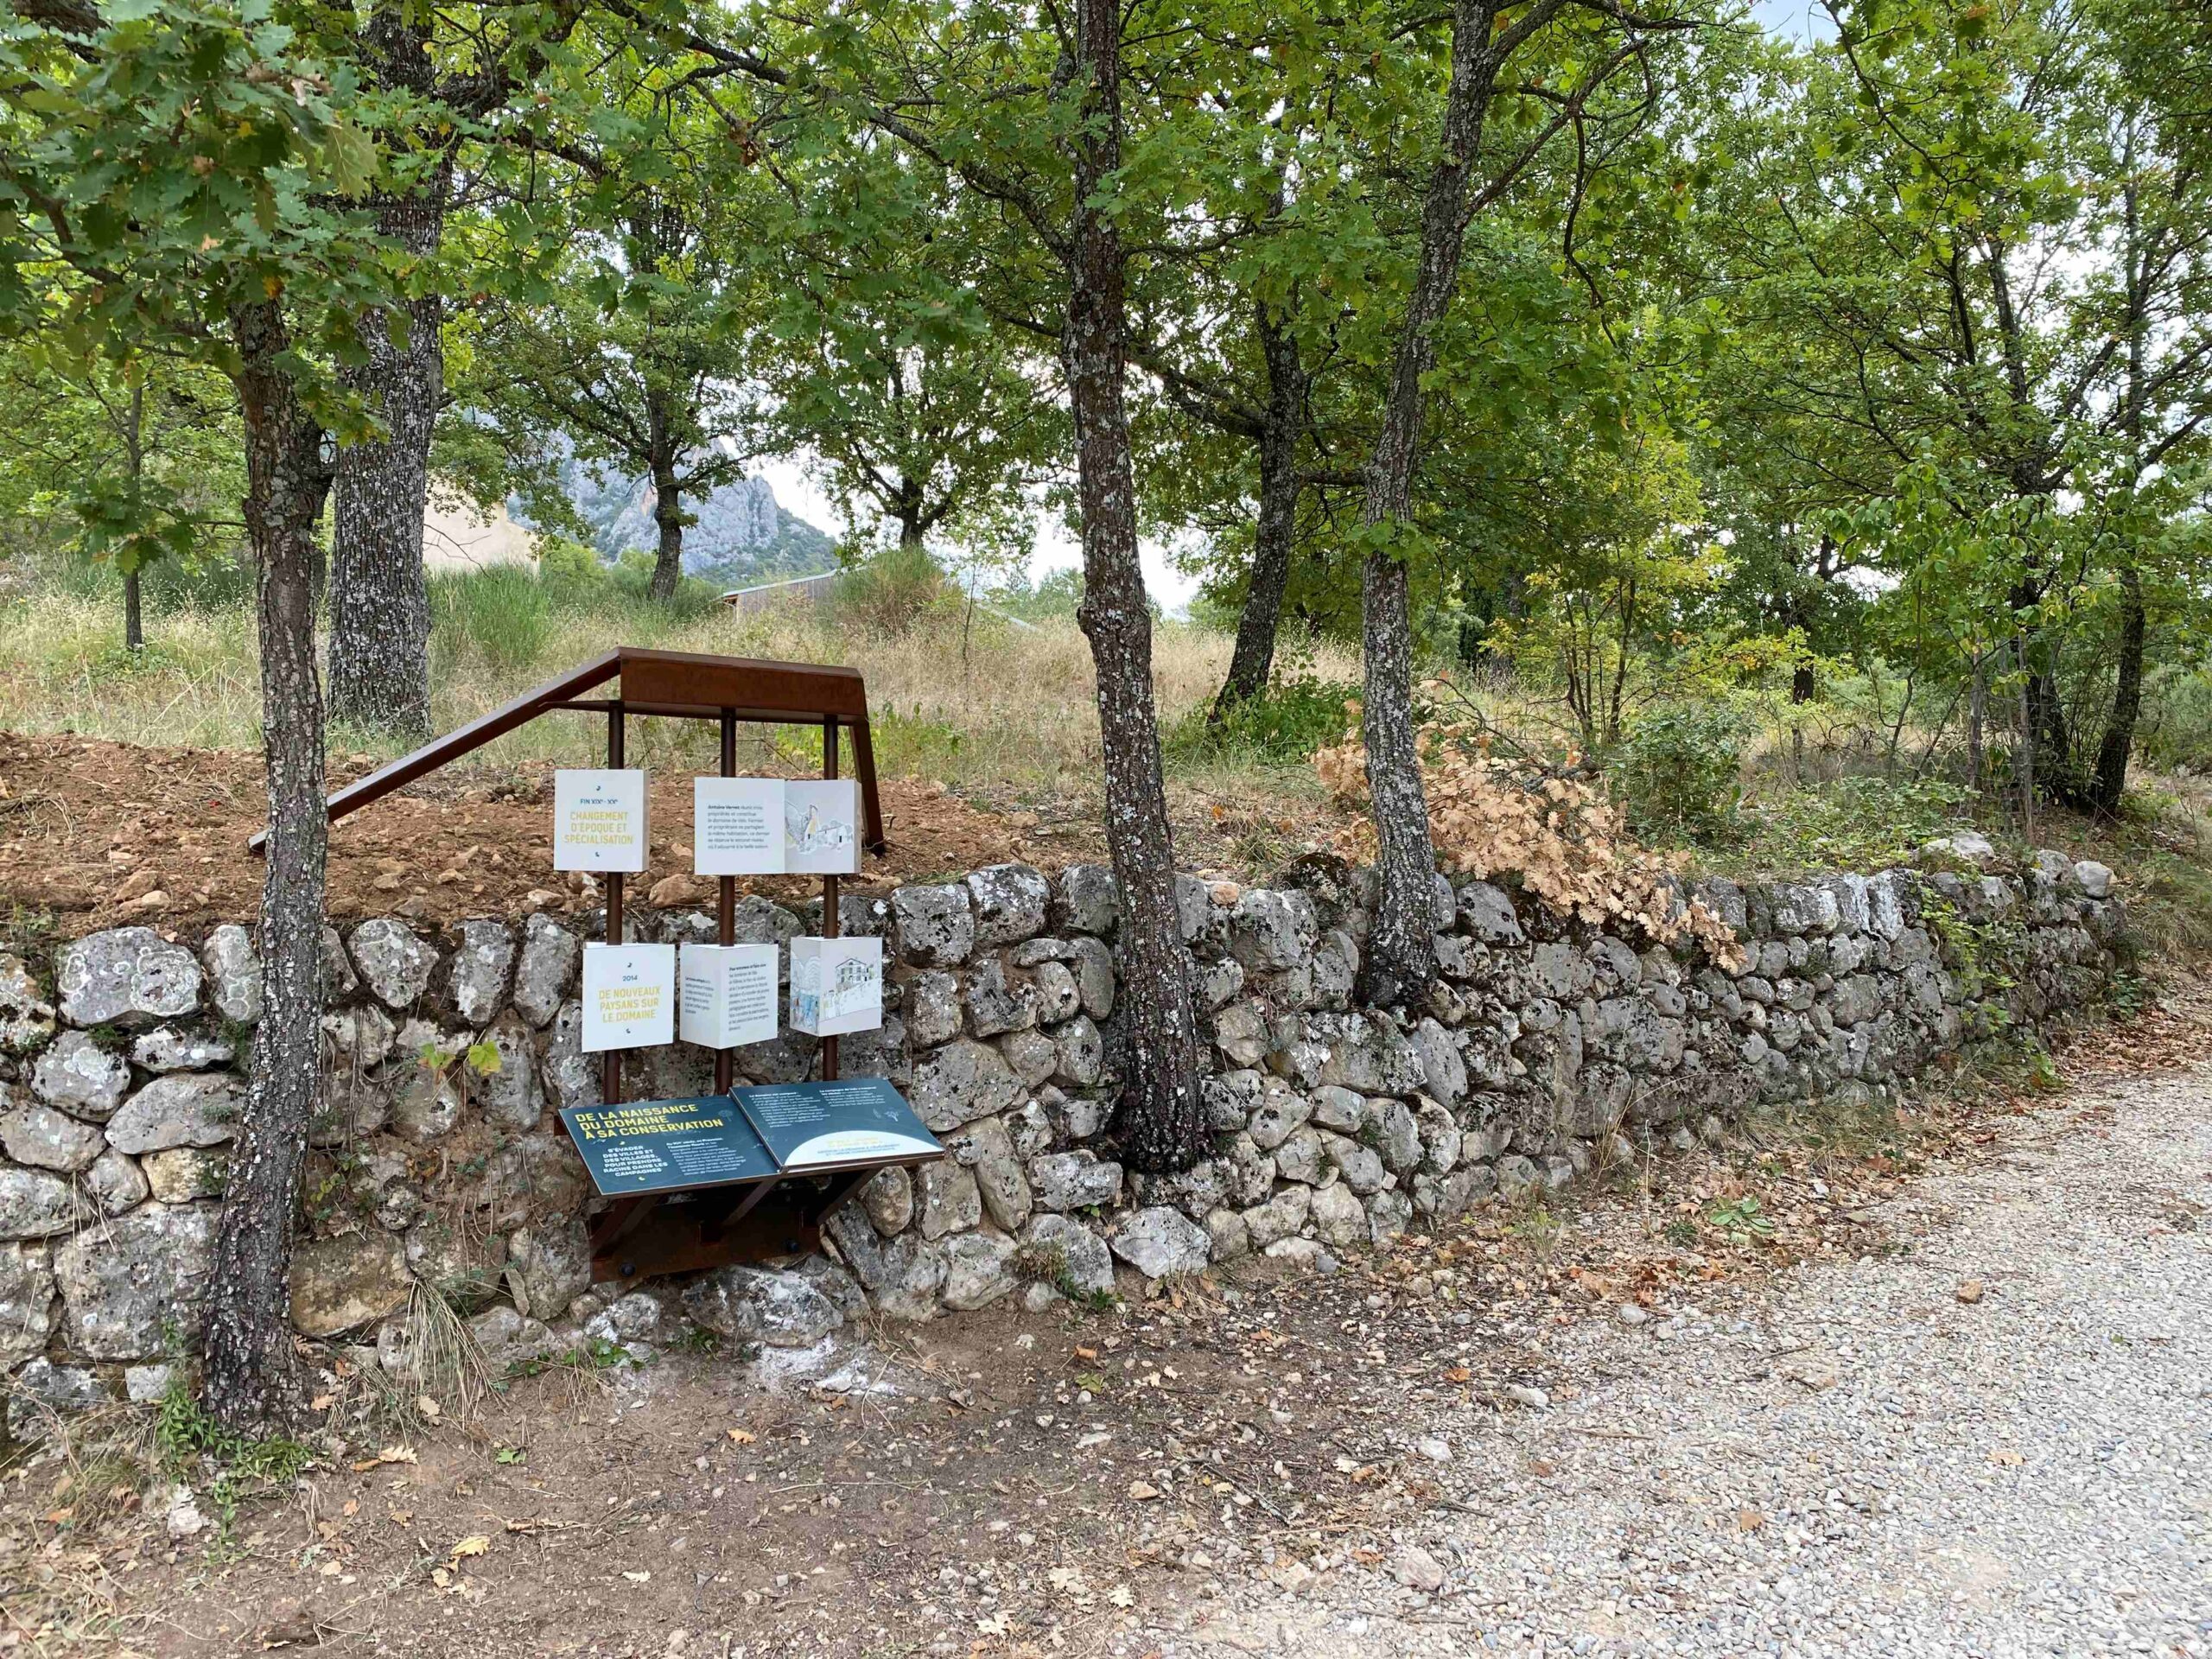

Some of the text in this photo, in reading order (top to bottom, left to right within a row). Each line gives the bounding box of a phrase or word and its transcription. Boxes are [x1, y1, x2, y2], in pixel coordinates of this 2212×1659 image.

[569, 811, 629, 821] CHANGEMENT
[617, 823, 627, 831] ET
[564, 833, 634, 845] SPÉCIALISATION
[599, 985, 661, 1000] DE NOUVEAUX
[600, 998, 658, 1011] PAYSANS SUR
[602, 1009, 656, 1023] LE DOMAINE
[575, 1104, 698, 1122] DE LA NAISSANCE
[579, 1115, 669, 1131] DU DOMAINE
[597, 1129, 617, 1139] SA
[619, 1118, 723, 1135] CONSERVATION
[614, 1168, 662, 1177] CAMPAGNES
